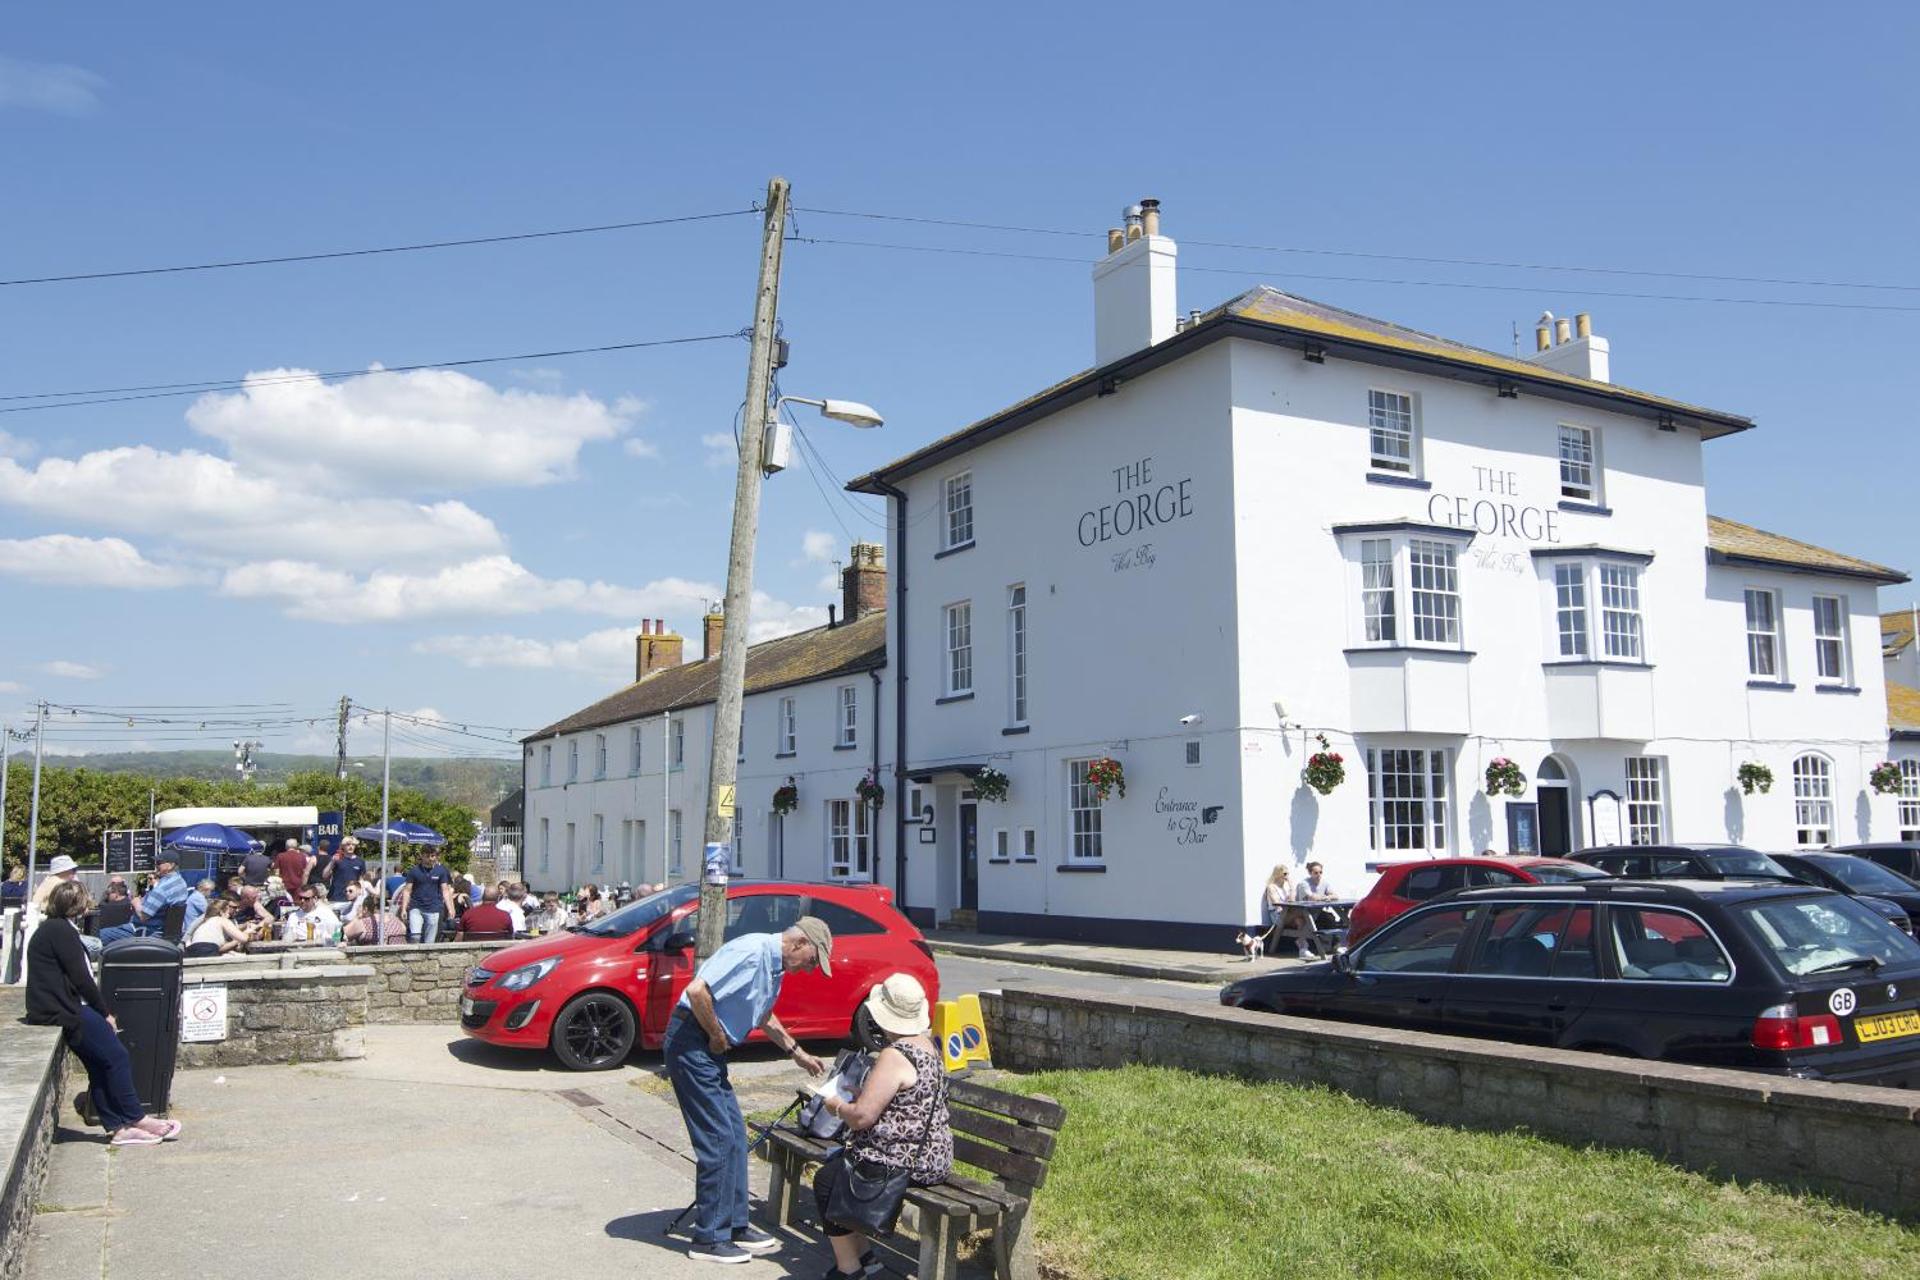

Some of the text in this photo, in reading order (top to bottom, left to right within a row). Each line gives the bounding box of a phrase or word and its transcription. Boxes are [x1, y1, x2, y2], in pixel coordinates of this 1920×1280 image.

[1112, 457, 1153, 494] THE
[1472, 465, 1519, 497] THE
[1078, 477, 1193, 548] GEORGE
[1427, 493, 1561, 544] GEORGE
[1155, 786, 1198, 814] Entrance
[184, 835, 223, 845] PALMERS
[318, 823, 339, 836] BAR
[1176, 817, 1208, 847] Bar
[1832, 992, 1852, 1012] GB
